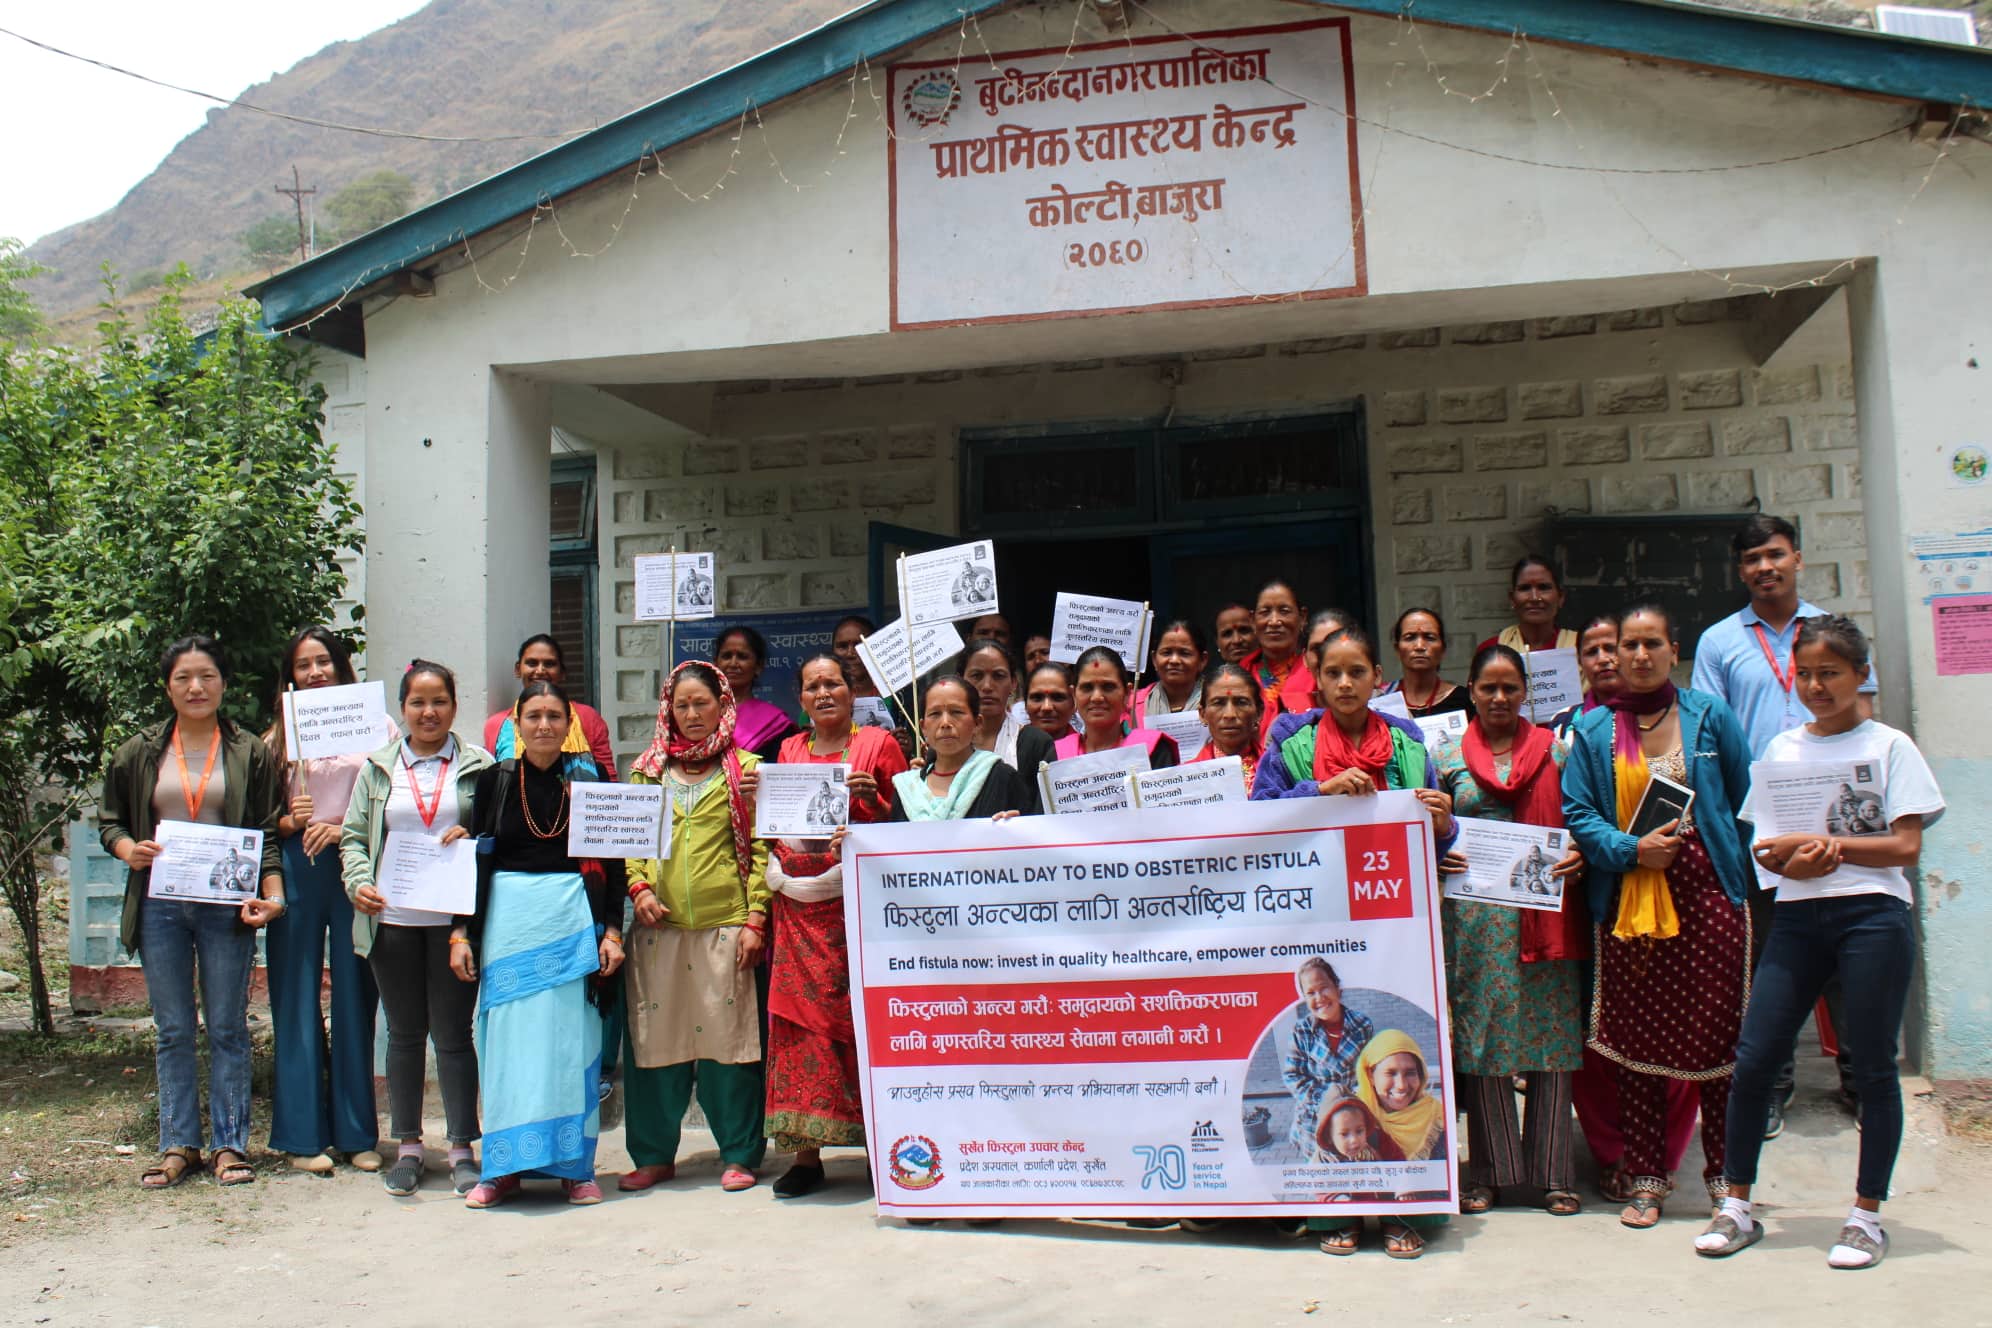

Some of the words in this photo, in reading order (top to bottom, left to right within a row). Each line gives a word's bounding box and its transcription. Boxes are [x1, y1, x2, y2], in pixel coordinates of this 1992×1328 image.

[929, 125, 1070, 178] प्राथमिक
[1075, 114, 1207, 162] स्वास्थ्य
[1211, 102, 1306, 149] केन्द्र
[769, 631, 834, 649] स्वास्थ्य
[882, 868, 1019, 888] INTERNATIONAL
[1024, 866, 1058, 882] DAY
[1063, 864, 1086, 880] TO
[1093, 862, 1129, 879] END
[1135, 855, 1237, 877] OBSTETRIC
[1244, 850, 1321, 871] FISTULA
[1362, 851, 1390, 872] 23
[1353, 878, 1403, 901] MAY
[884, 902, 960, 934] फिस्टुला
[968, 901, 1059, 926] अन्त्यका
[1066, 893, 1120, 922] लागि
[1254, 884, 1313, 914] दिवस
[889, 956, 915, 971] End
[919, 956, 958, 970] fistula
[962, 957, 994, 969] now:
[997, 954, 1038, 968] invest
[1042, 952, 1054, 967] in
[1059, 951, 1108, 969] quality
[1112, 948, 1192, 964] healthcare,
[1196, 945, 1266, 962] empower
[1270, 939, 1367, 957] communities
[888, 996, 968, 1021] फिस्टुलाको
[973, 999, 1015, 1016] अन्त्य
[1141, 989, 1258, 1013] सशक्तिकरणका
[890, 1030, 927, 1052] लागि
[931, 1028, 1005, 1054] गुणस्तरिय
[1010, 1032, 1064, 1050] स्वास्थ्य
[1070, 1027, 1116, 1049] सेवामा
[1121, 1025, 1174, 1047] लगानी
[948, 1084, 975, 1100] प्रसव
[1029, 1141, 1058, 1153] उपचार
[1192, 1162, 1213, 1170] Years
[1214, 1162, 1223, 1170] of
[1193, 1171, 1221, 1179] service
[1193, 1181, 1201, 1189] in
[1203, 1180, 1227, 1190] Nepal
